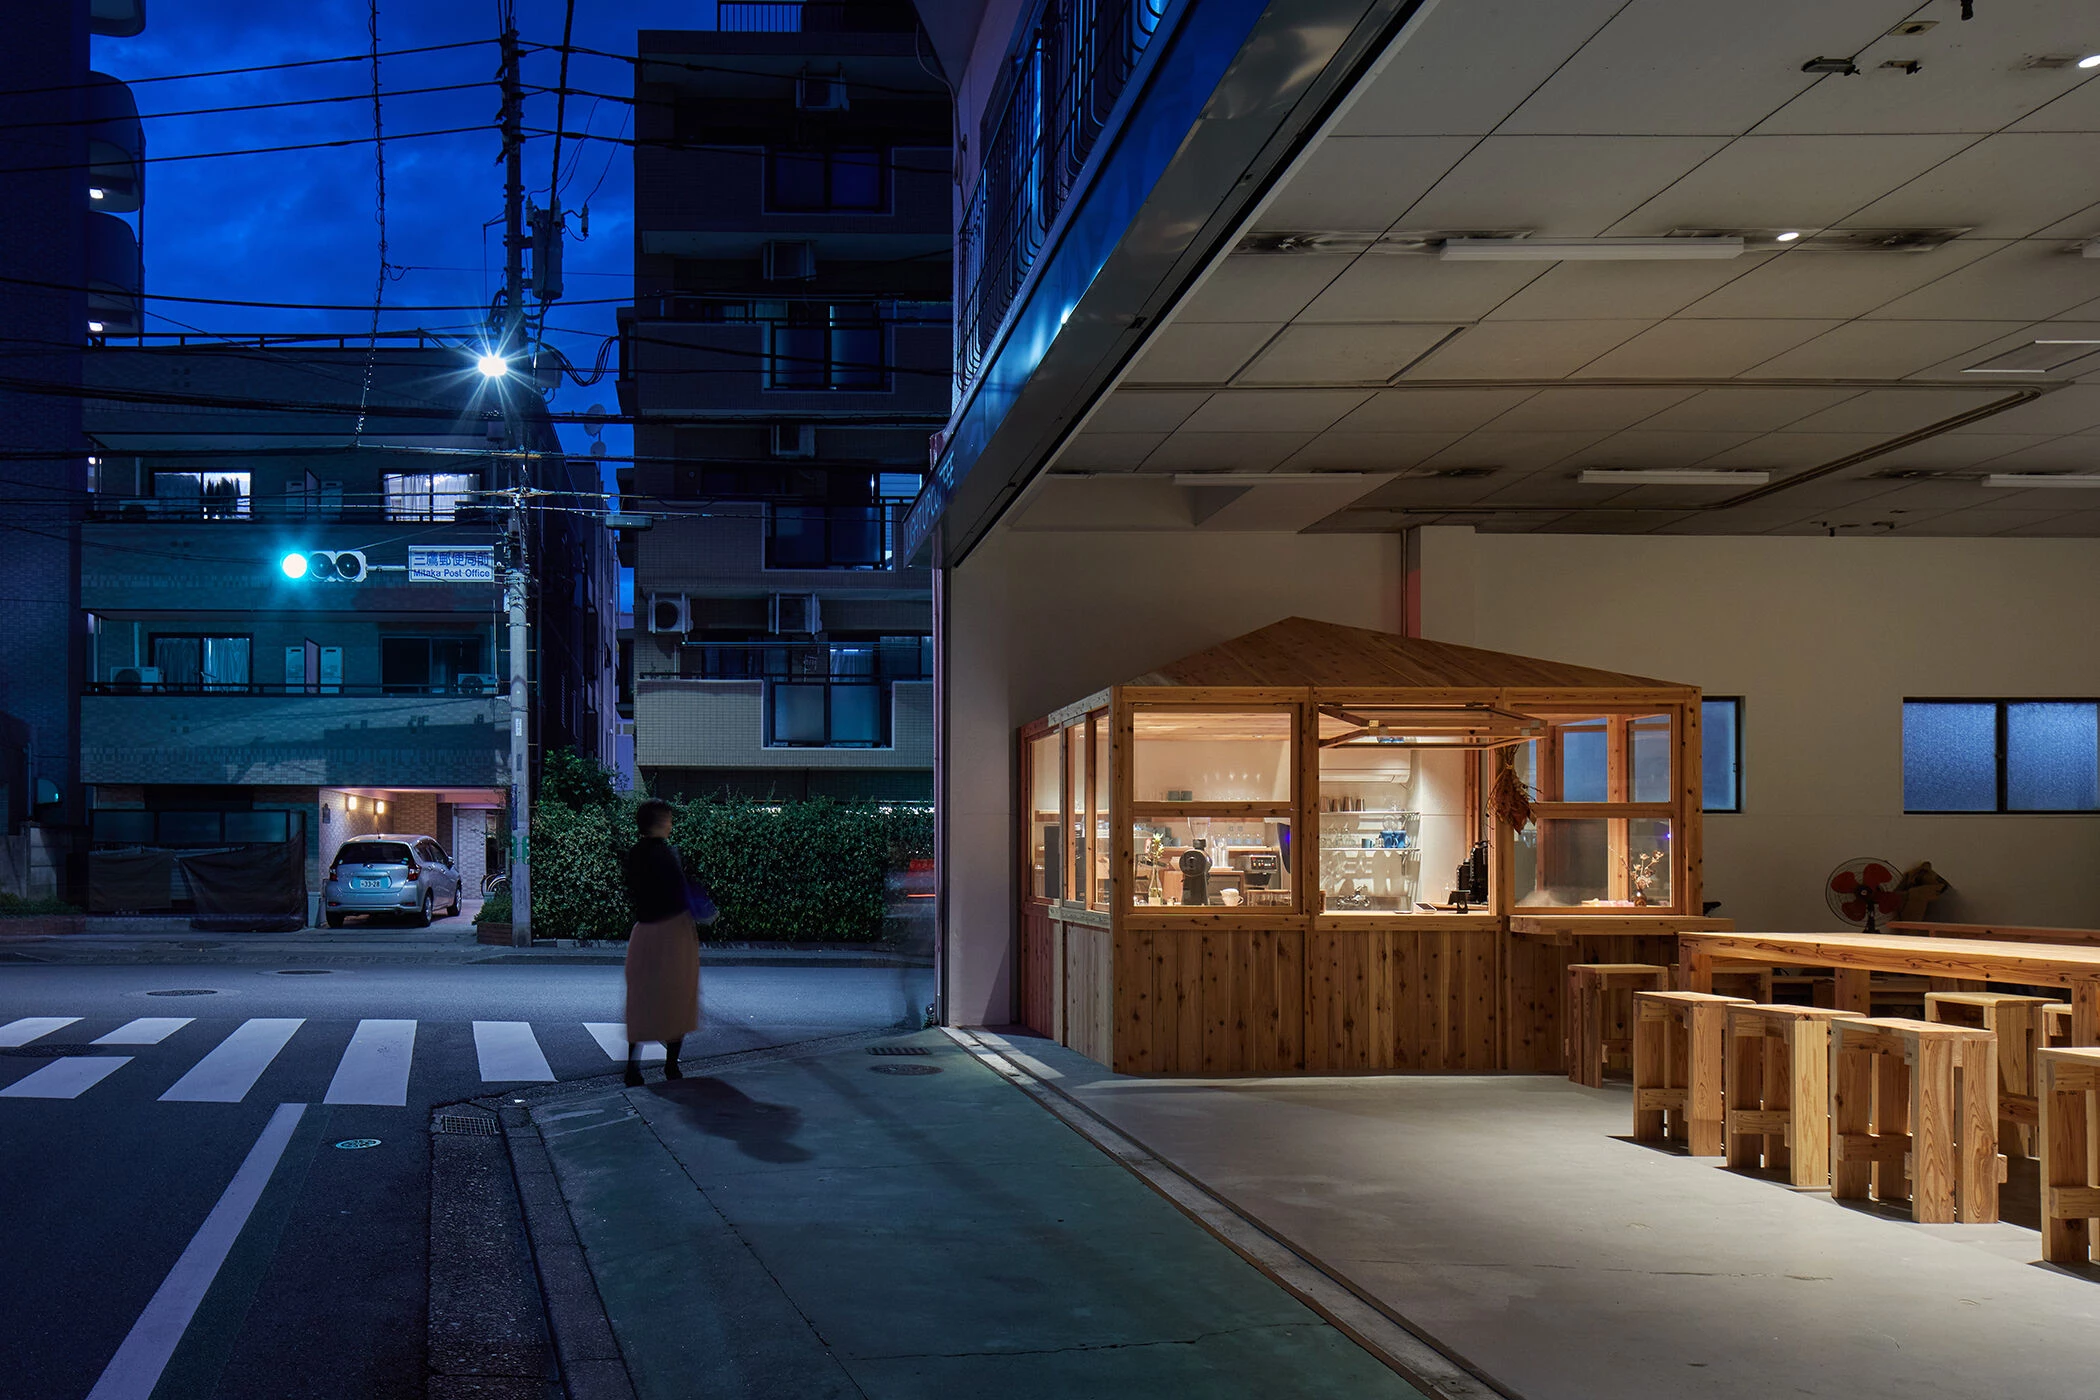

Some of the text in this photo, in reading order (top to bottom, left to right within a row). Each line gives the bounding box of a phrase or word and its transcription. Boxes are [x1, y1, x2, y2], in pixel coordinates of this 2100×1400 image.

[414, 552, 489, 566] 三鷹郵便局前
[413, 568, 490, 577] Mitaka Post Office
